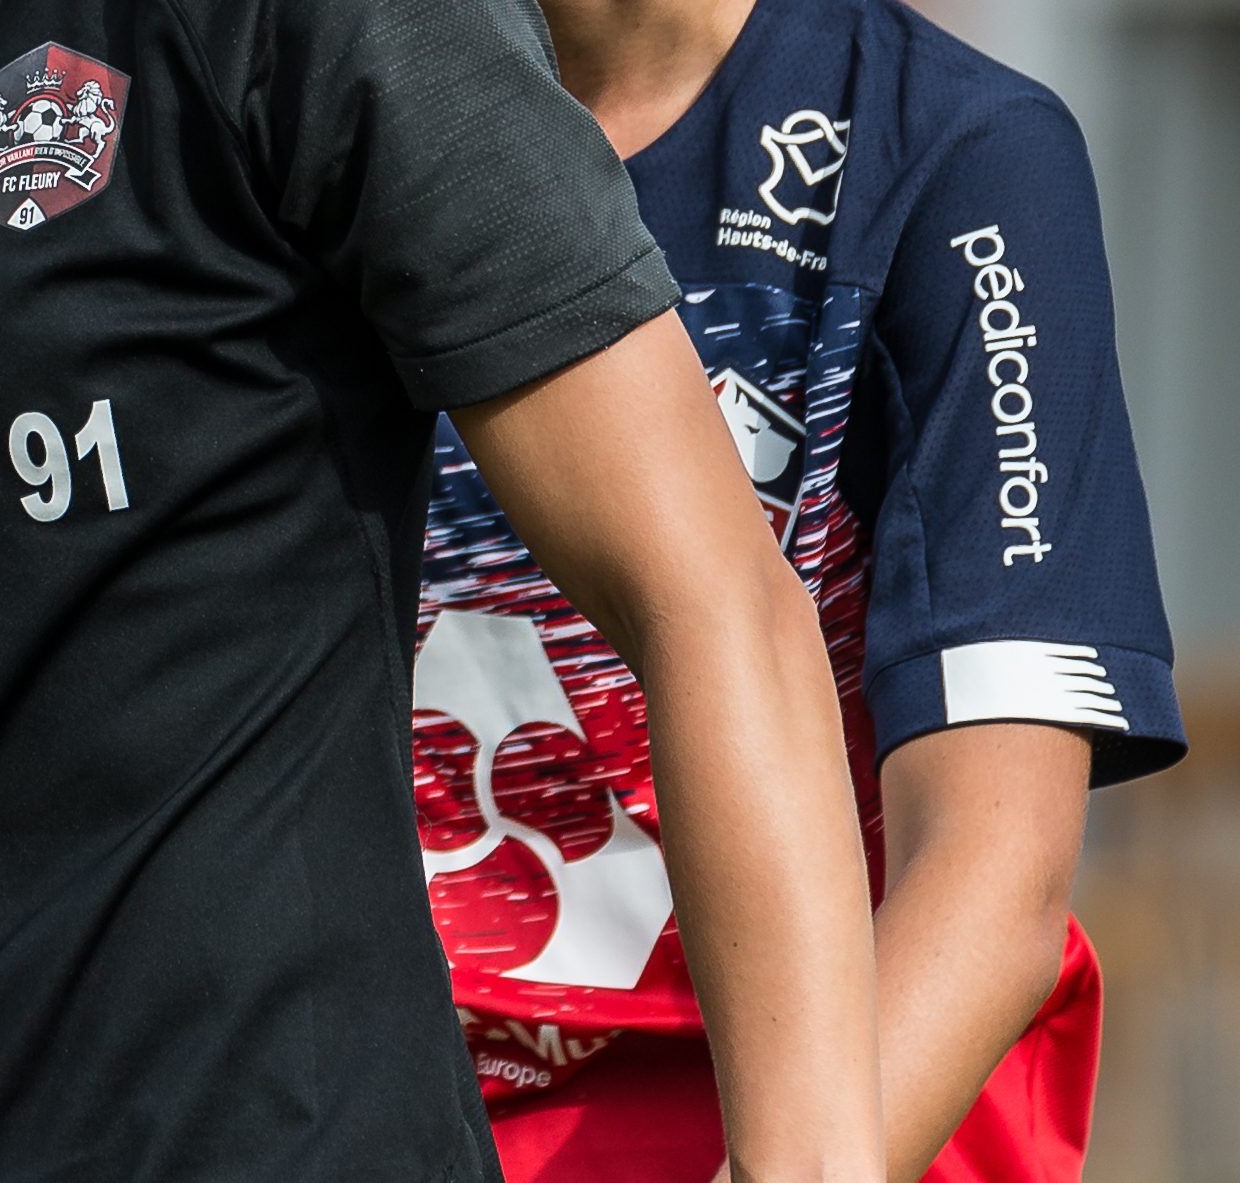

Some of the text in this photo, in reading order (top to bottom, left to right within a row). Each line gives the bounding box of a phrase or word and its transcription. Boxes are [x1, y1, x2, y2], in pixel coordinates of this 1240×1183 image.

[2, 171, 61, 193] FC FLEURY
[19, 206, 35, 225] 91
[720, 207, 772, 229] Région
[950, 224, 1052, 567] pédiconfort
[8, 398, 130, 523] 91
